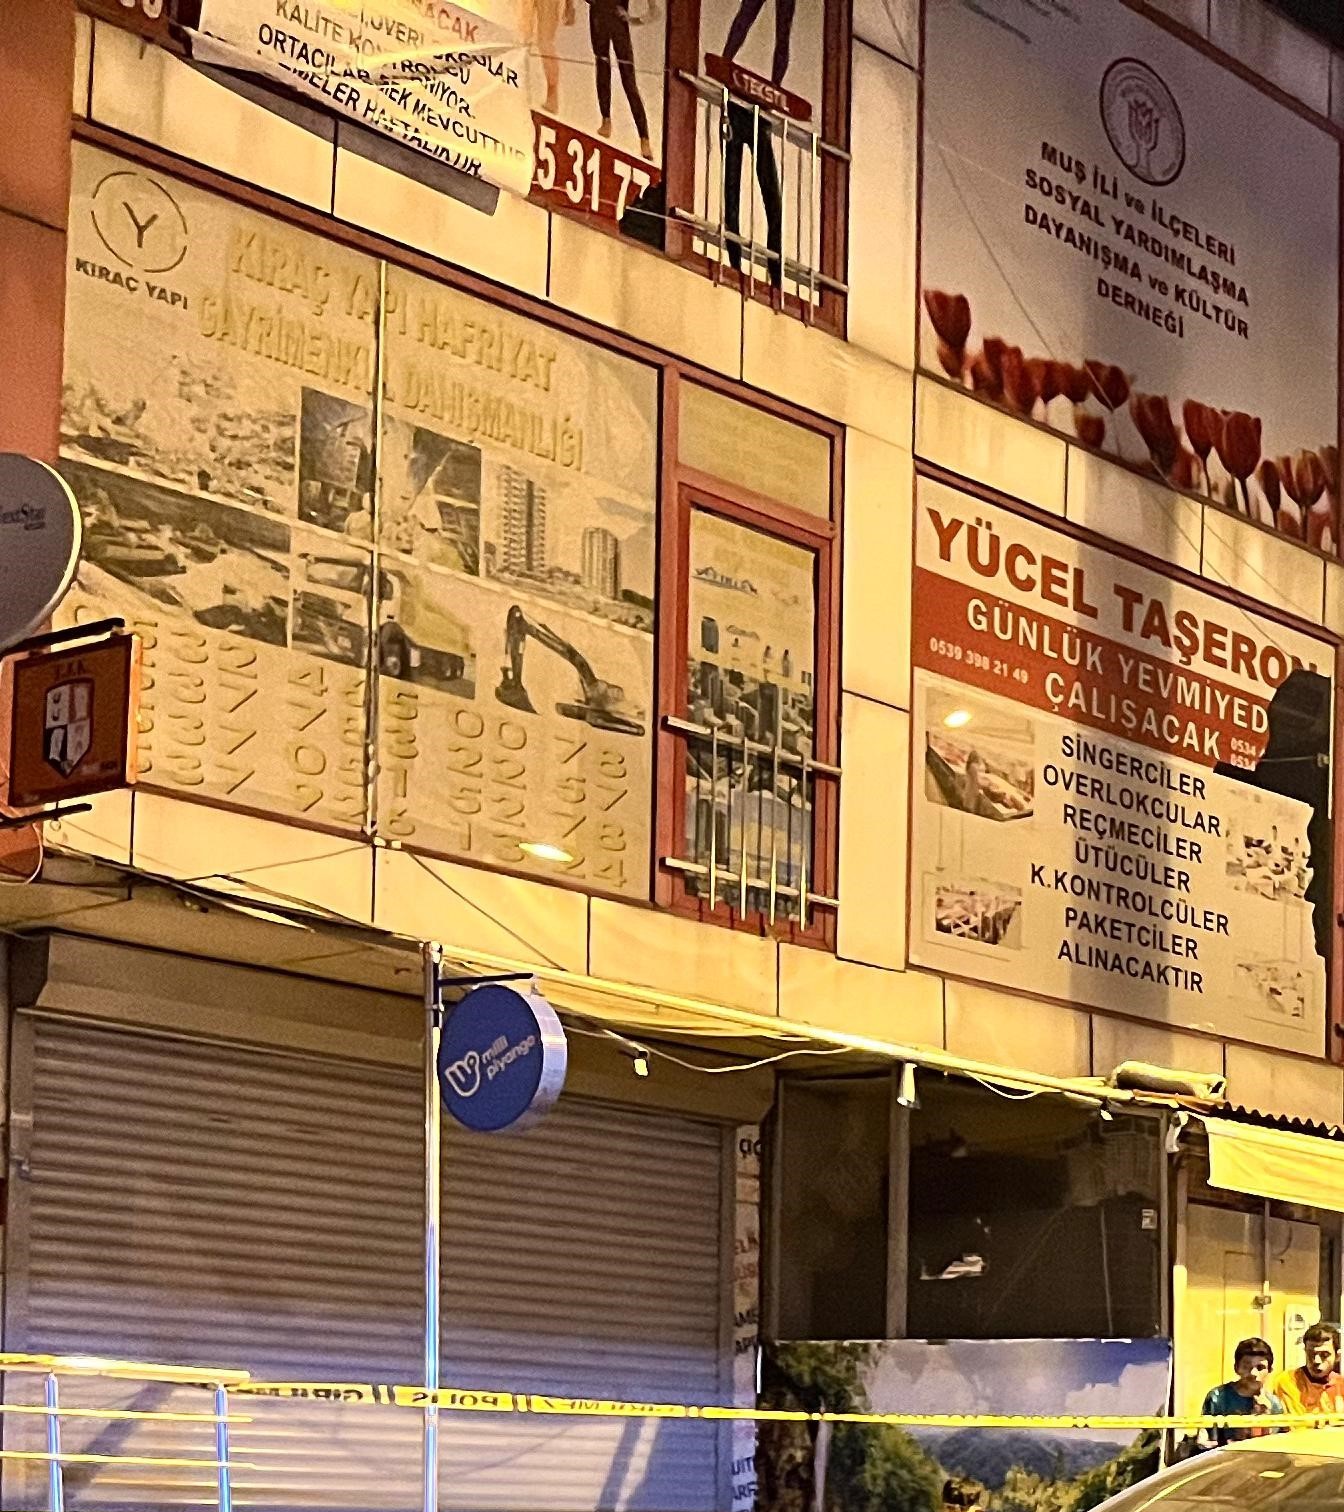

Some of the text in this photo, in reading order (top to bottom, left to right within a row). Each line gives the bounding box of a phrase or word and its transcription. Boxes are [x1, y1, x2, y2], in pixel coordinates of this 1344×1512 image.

[565, 138, 600, 212] 31
[1042, 141, 1236, 266] MUŞ İLİ ve İLÇELERİ
[1024, 203, 1249, 340] DAYANIŞMA ve KÜLTÜR
[1025, 168, 1250, 307] SOSYAL YARDIMLAŞMA
[145, 282, 188, 310] YAPI
[1097, 277, 1184, 339] DERNEĞİ
[926, 507, 1099, 620] YÜCEL
[966, 597, 1104, 675] GÜNLÜK
[1043, 671, 1222, 761] ÇALIŞACAK
[1043, 764, 1222, 838] OVERLOKCULAR
[1061, 733, 1207, 800] SİNGERCİLER
[1063, 803, 1203, 864] REÇMECİLER
[1074, 836, 1191, 893] ÜTÜCÜLER
[1030, 862, 1231, 937] K.KONTROLCÜLER
[1065, 906, 1199, 960] PAKETCİLER
[1057, 939, 1204, 994] ALINACAKTIR
[481, 1034, 509, 1065] milli
[486, 1034, 536, 1081] piyango
